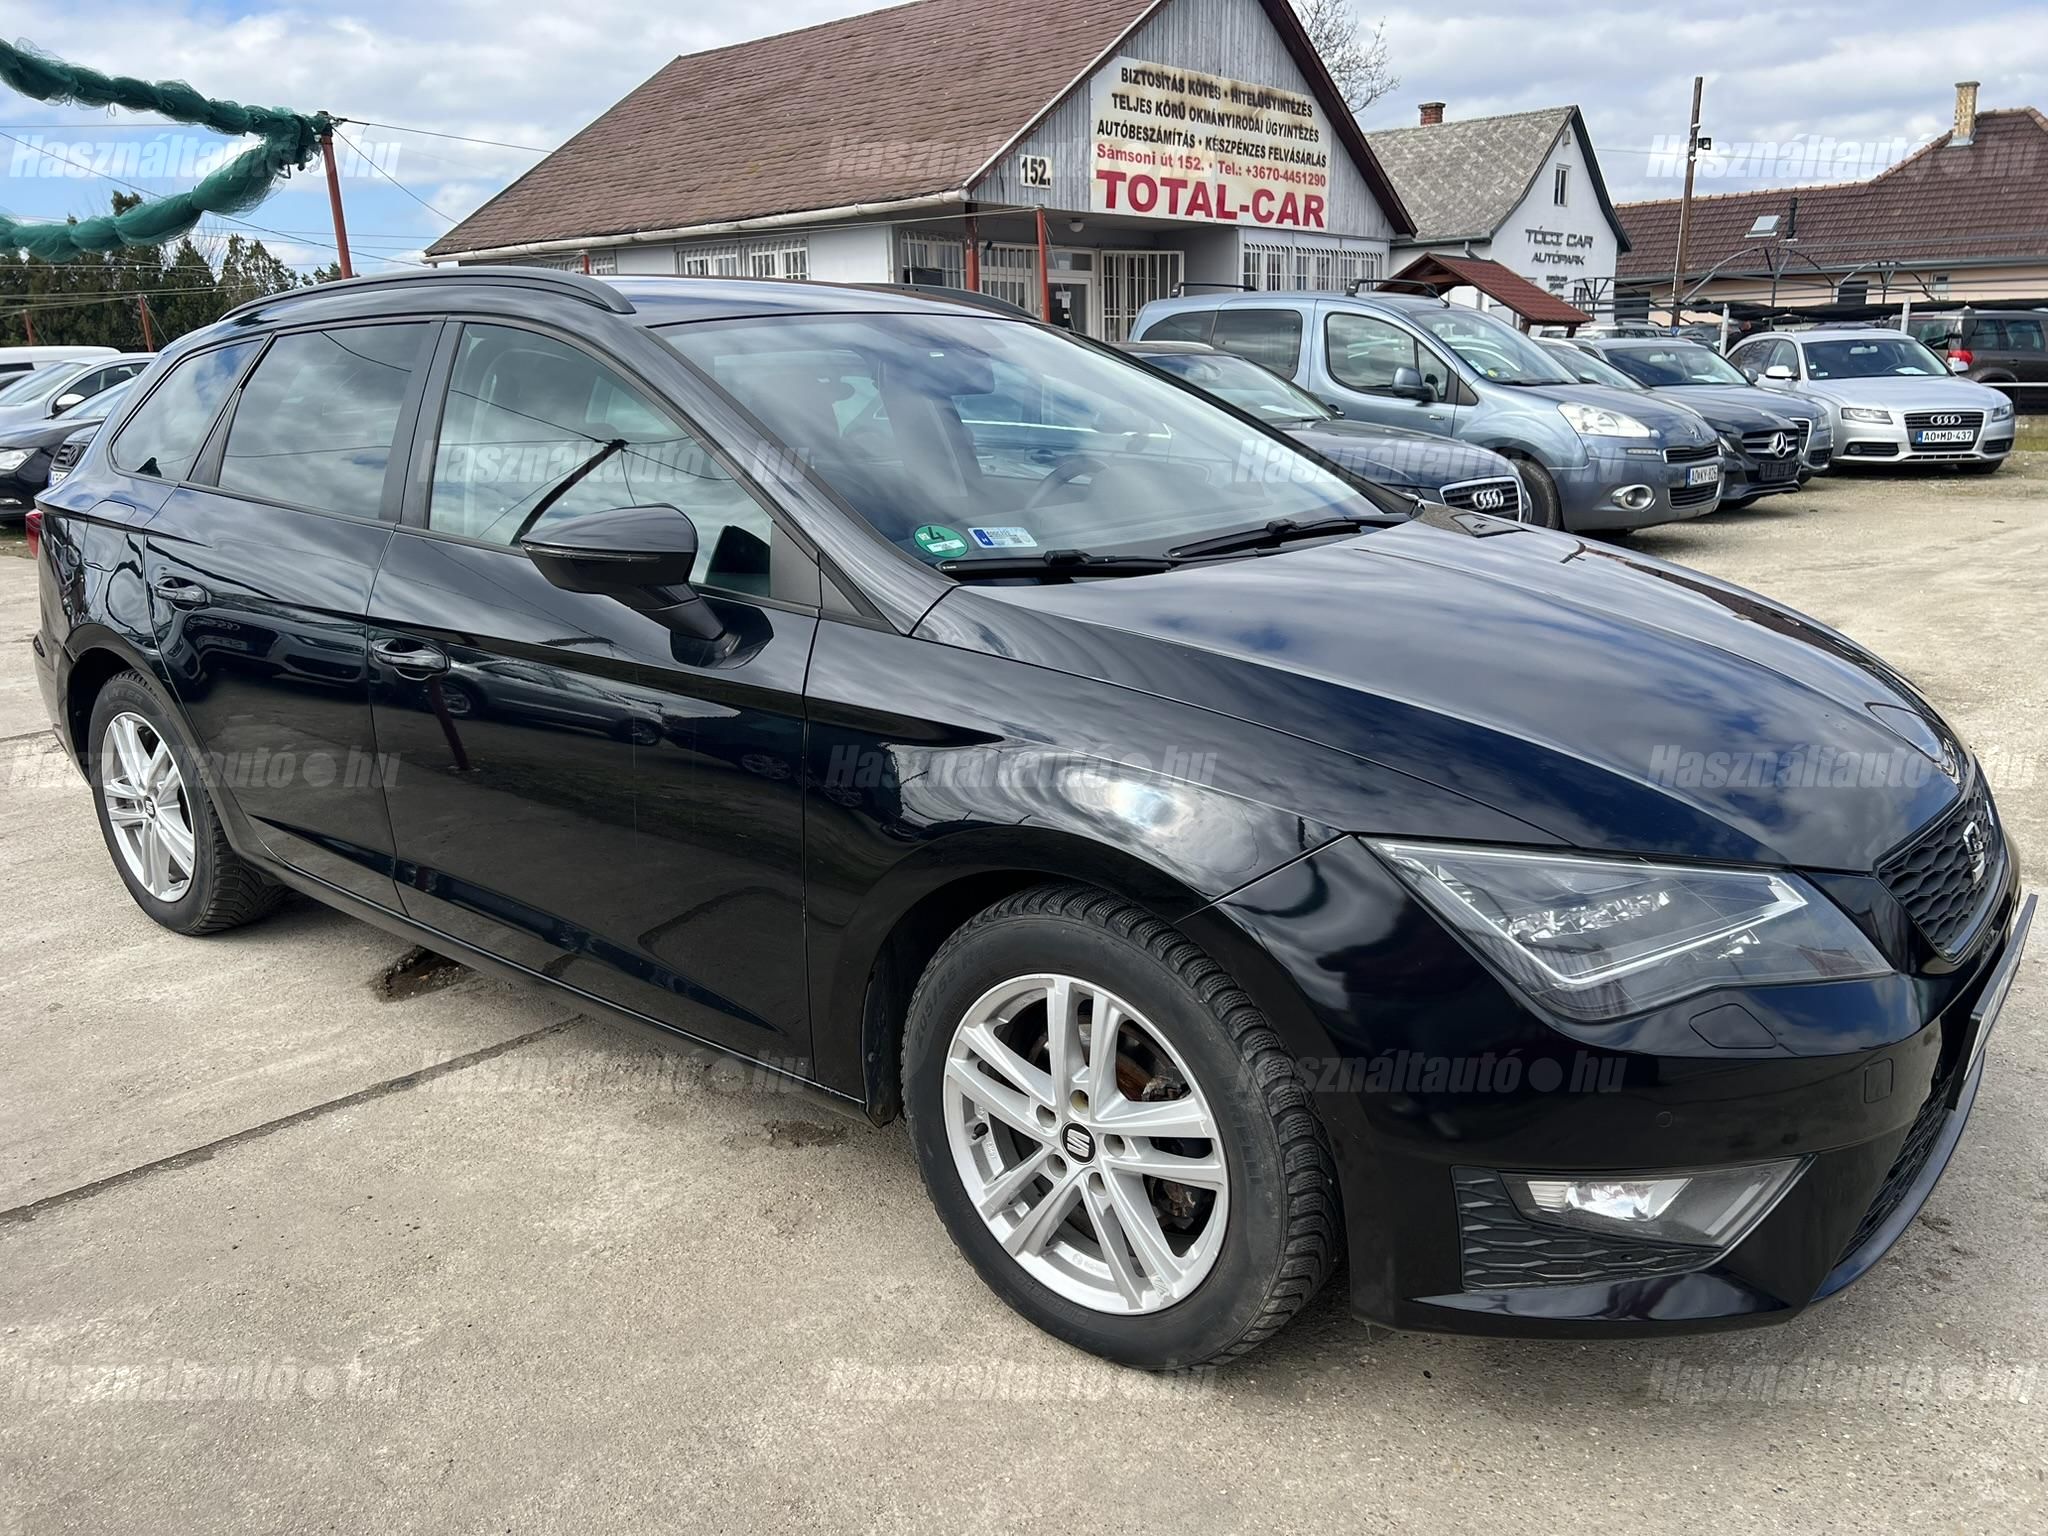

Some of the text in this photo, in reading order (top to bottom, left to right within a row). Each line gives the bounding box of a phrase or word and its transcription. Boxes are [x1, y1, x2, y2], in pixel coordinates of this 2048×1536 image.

[1121, 67, 1185, 94] BIZTOSÍTÁS
[1188, 78, 1221, 100] KÖTÉS
[1112, 93, 1152, 115] TELJES
[1189, 106, 1264, 133] OKMÁNYIRODAI
[1265, 117, 1320, 143] ÜGYINTÉZÉS
[1096, 119, 1327, 169] AUTÓBESZÁMÍTÁS KÉSZPÉNZES FELVÁSÁRLÁS
[1021, 156, 1051, 187] 152.
[1096, 143, 1327, 187] Sámsoni út 152. Tel.: +3670-4451290
[1095, 169, 1325, 228] TOTAL-CAR
[1531, 250, 1586, 266] AUTÓPARK
[1566, 233, 1594, 249] CAR
